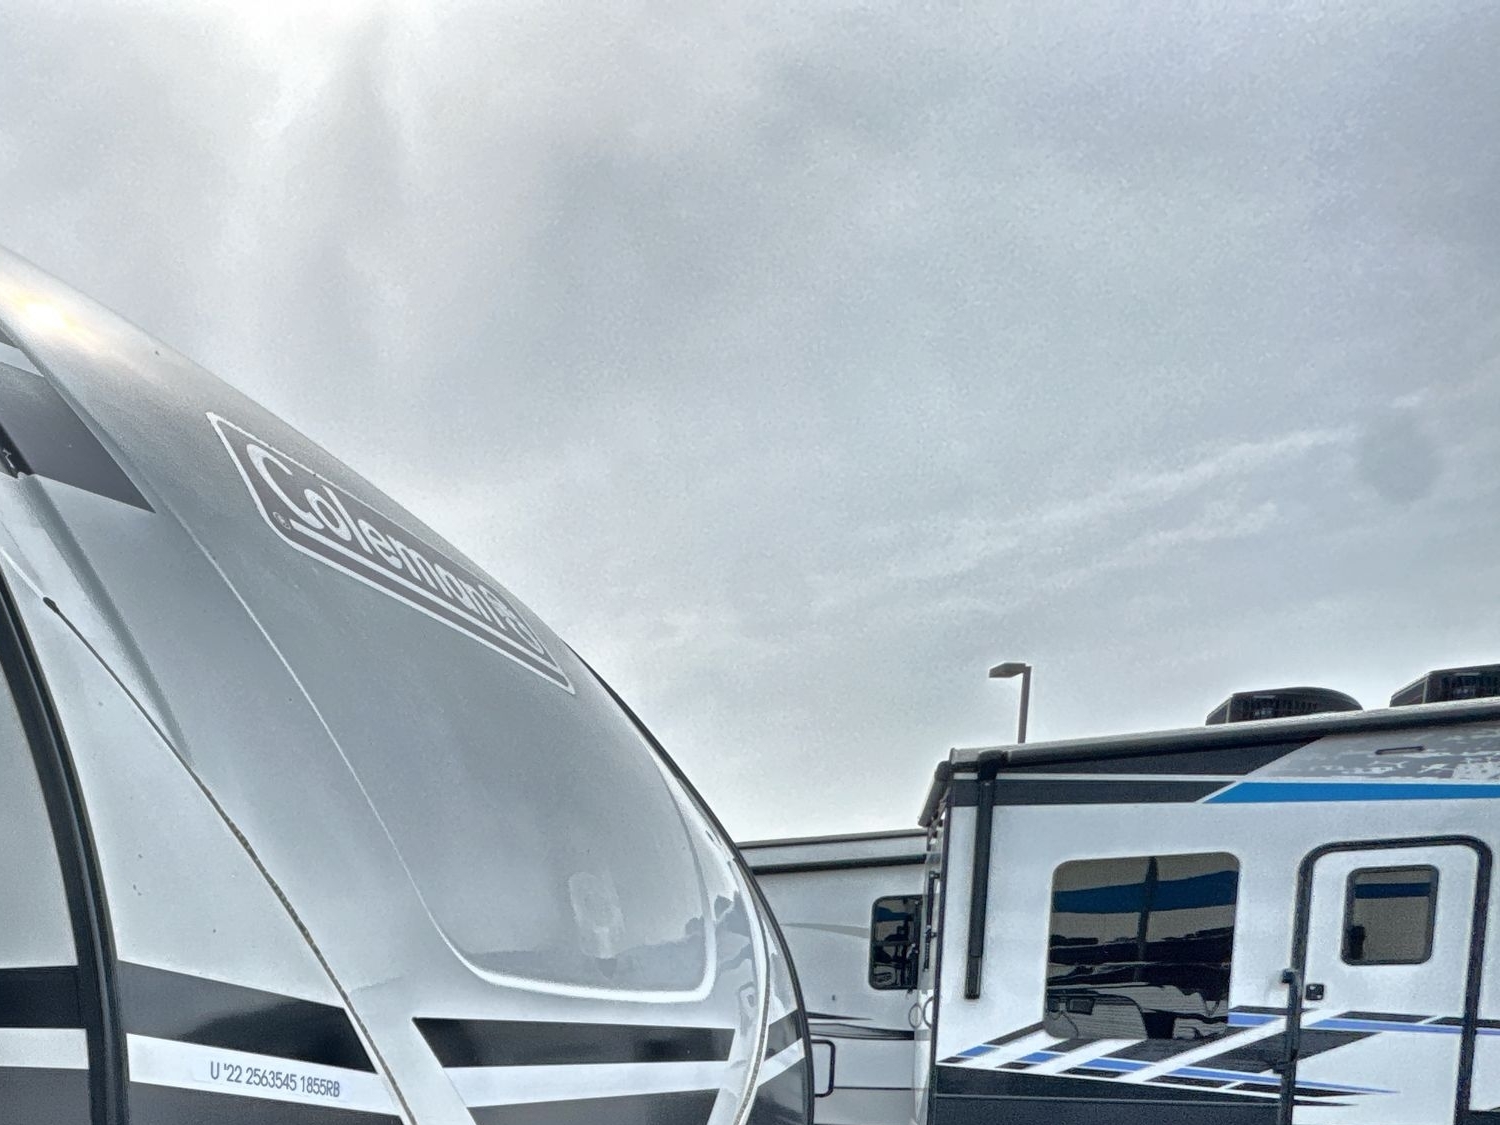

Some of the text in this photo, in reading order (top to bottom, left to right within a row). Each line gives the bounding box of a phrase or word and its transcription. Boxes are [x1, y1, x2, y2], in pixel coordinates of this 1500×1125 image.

[246, 443, 507, 631] Coleman
[210, 1060, 341, 1098] U '22 2563545 1855RB
